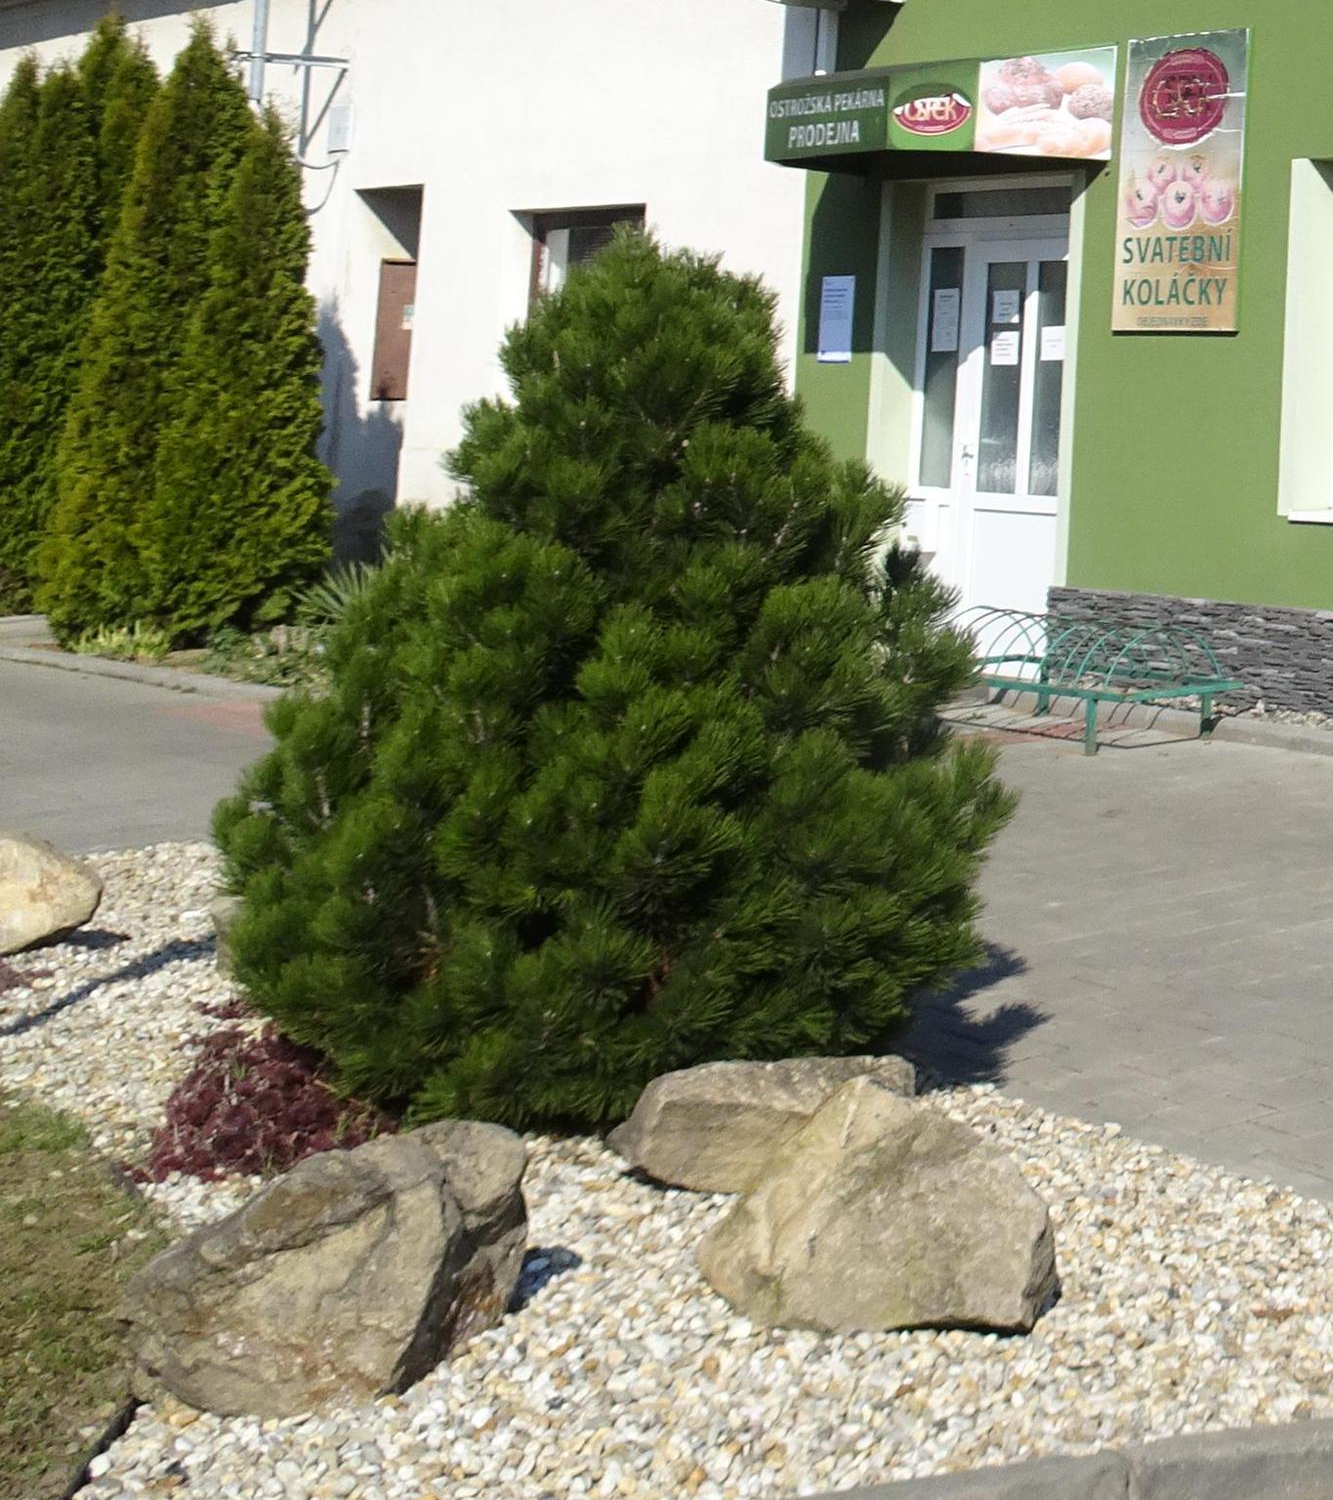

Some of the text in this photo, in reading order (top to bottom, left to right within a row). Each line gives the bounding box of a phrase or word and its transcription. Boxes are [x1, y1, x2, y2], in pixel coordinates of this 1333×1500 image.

[769, 87, 885, 118] OSTROŽSKÁ PEKÁRNA
[788, 120, 860, 148] PRODEJNA
[1122, 228, 1232, 264] SVATEBNÍ
[1122, 272, 1228, 306] KOLÁČKY
